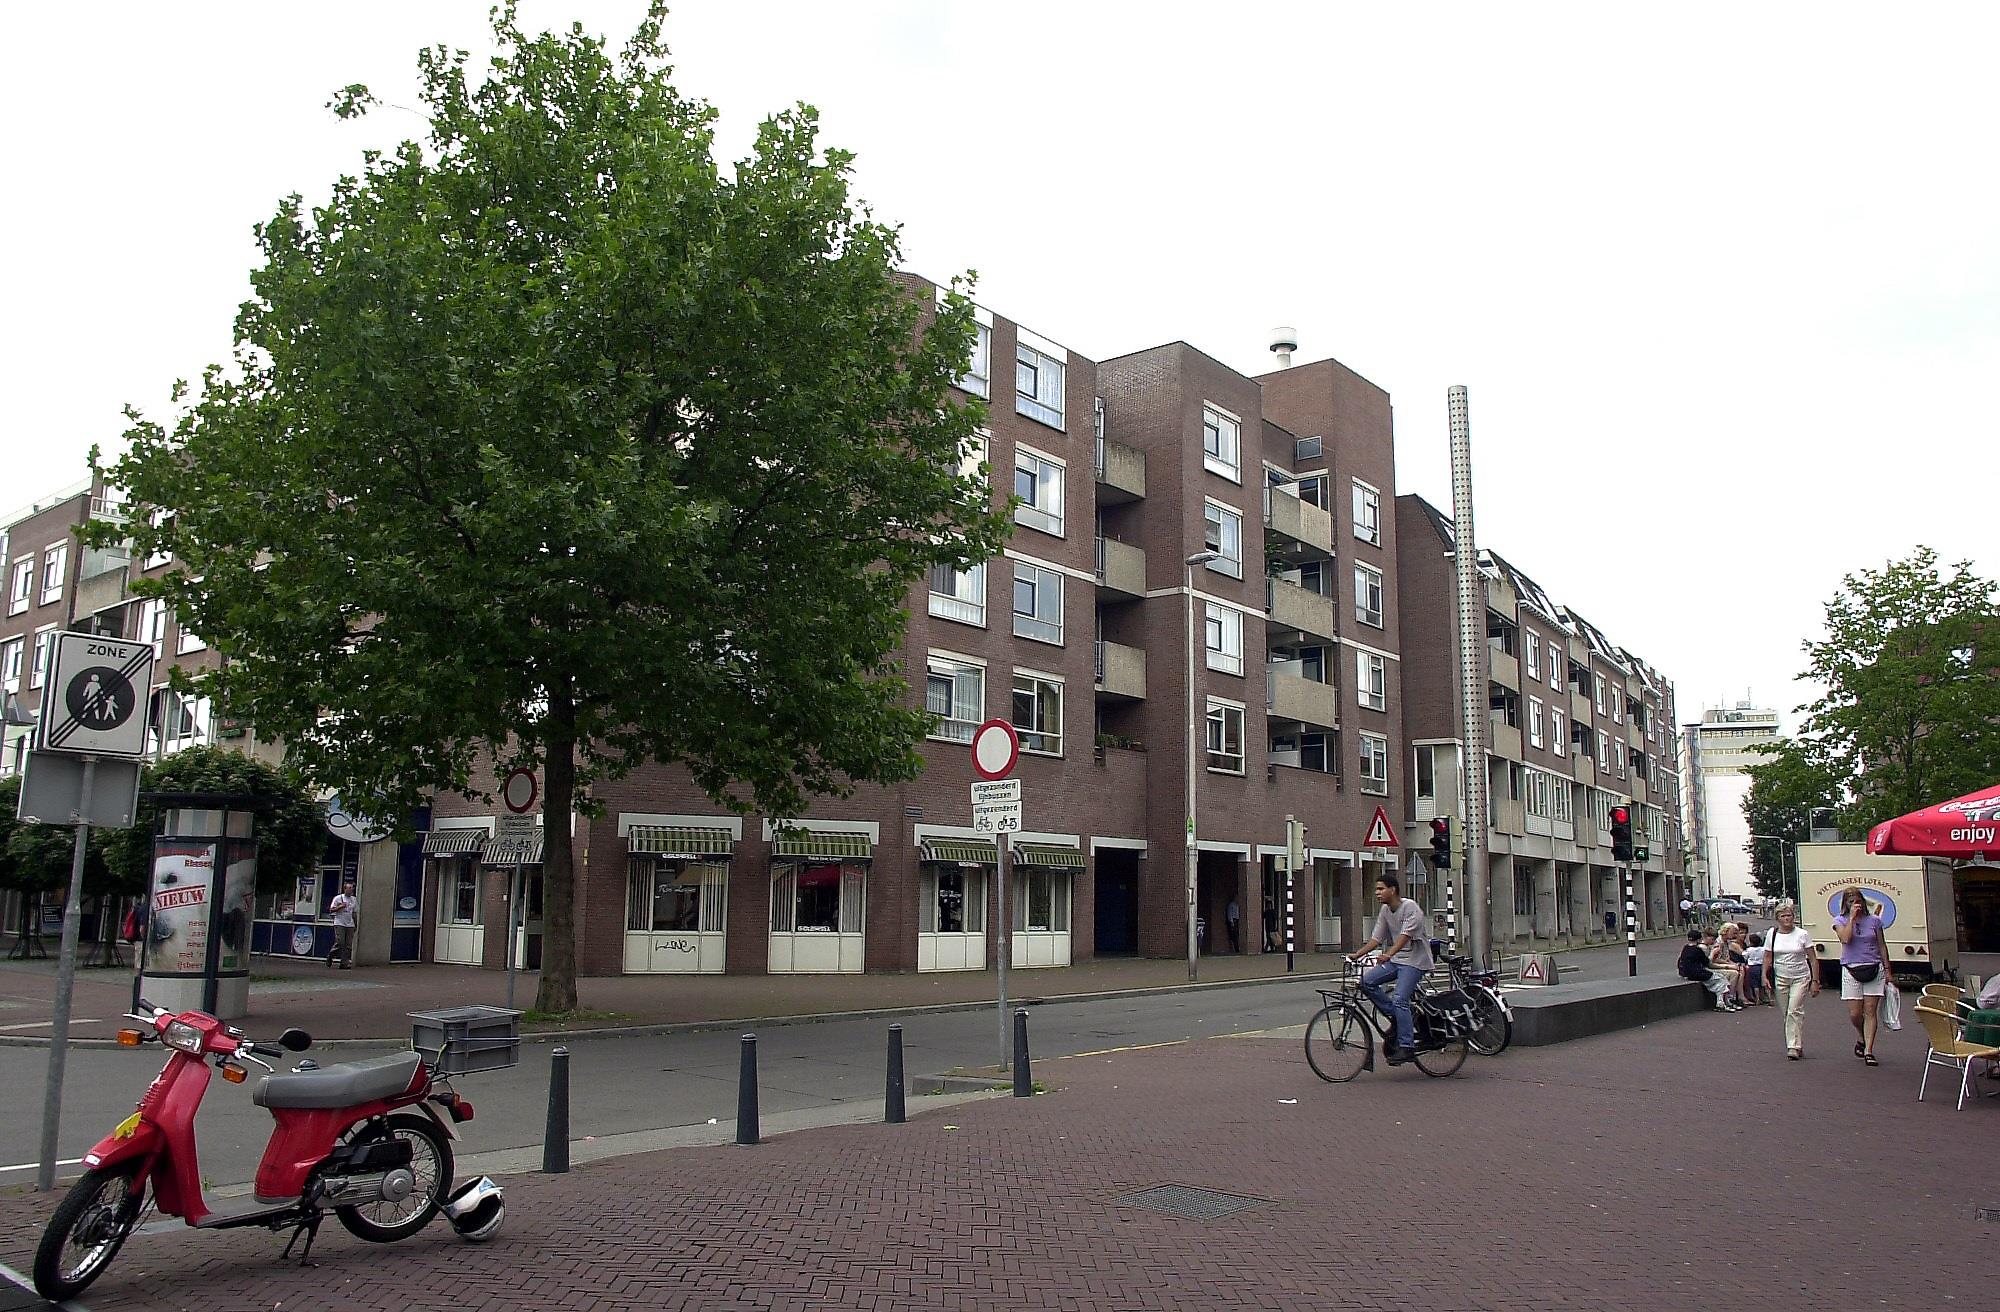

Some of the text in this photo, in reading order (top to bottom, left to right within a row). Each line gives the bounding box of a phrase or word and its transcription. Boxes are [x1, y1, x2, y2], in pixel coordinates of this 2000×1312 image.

[87, 643, 128, 658] ZONE
[1950, 823, 1995, 844] enjoy
[155, 889, 205, 908] NIEUW
